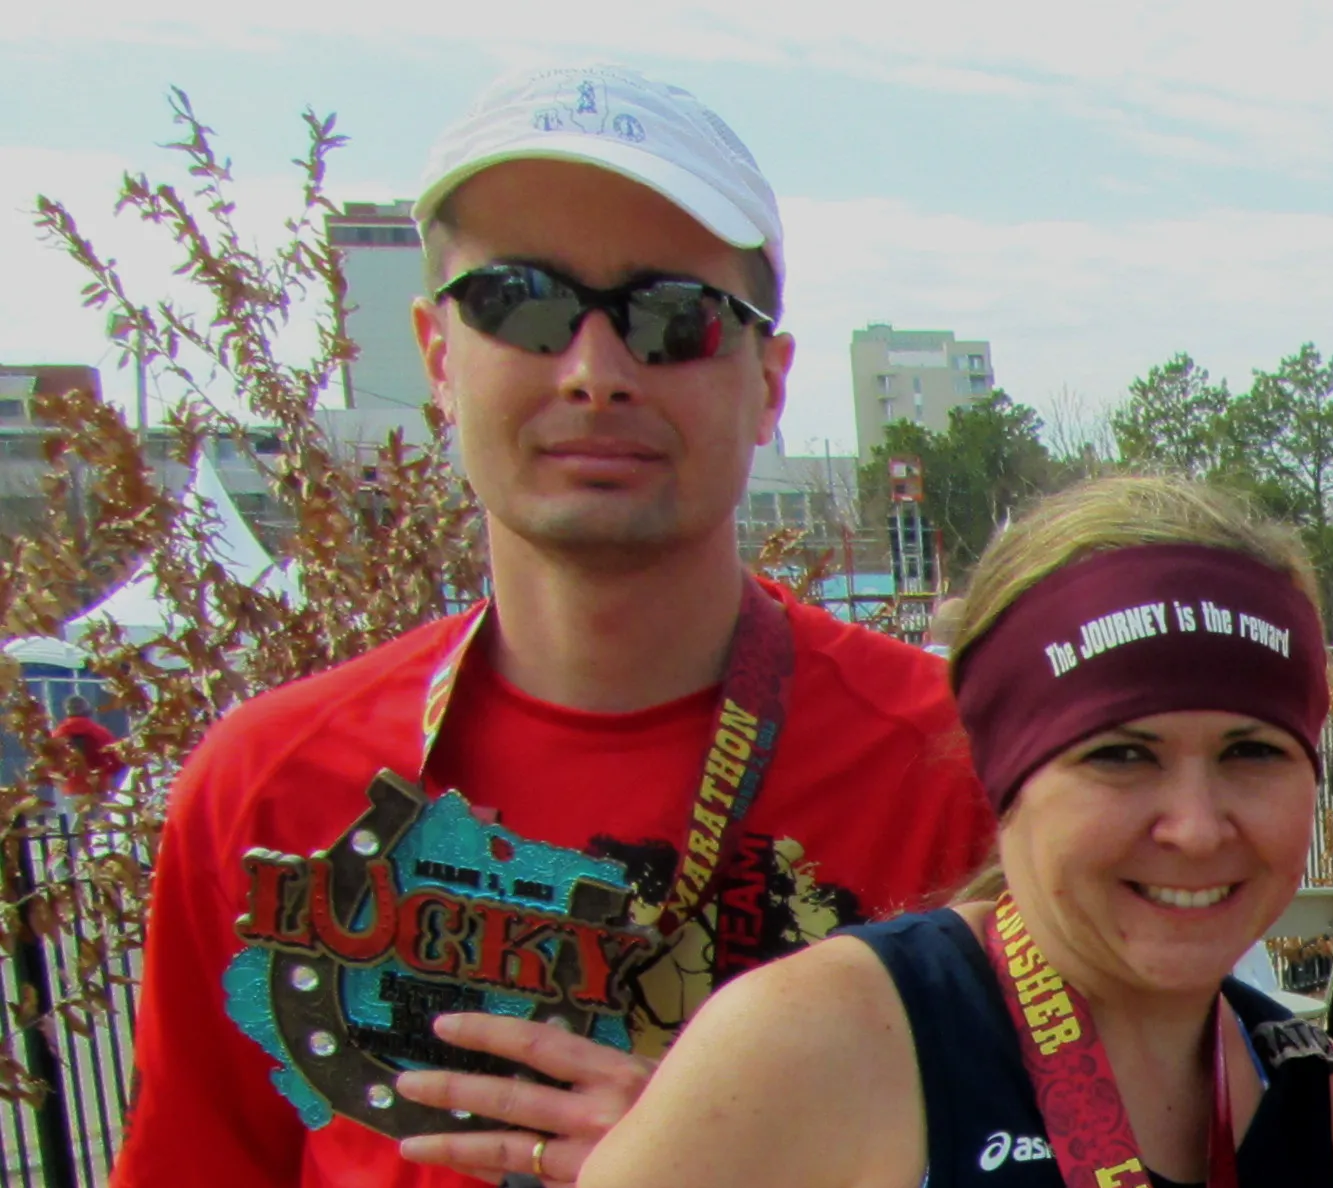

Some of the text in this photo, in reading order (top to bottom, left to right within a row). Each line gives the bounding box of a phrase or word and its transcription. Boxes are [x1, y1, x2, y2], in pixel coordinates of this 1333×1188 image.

[1080, 602, 1167, 659] JOURNEY
[1173, 601, 1196, 632] is
[1202, 601, 1232, 634] the
[1239, 613, 1291, 658] reward
[672, 699, 760, 916] MARATHON
[238, 851, 660, 1010] LUCKY
[995, 889, 1081, 1056] INISHER
